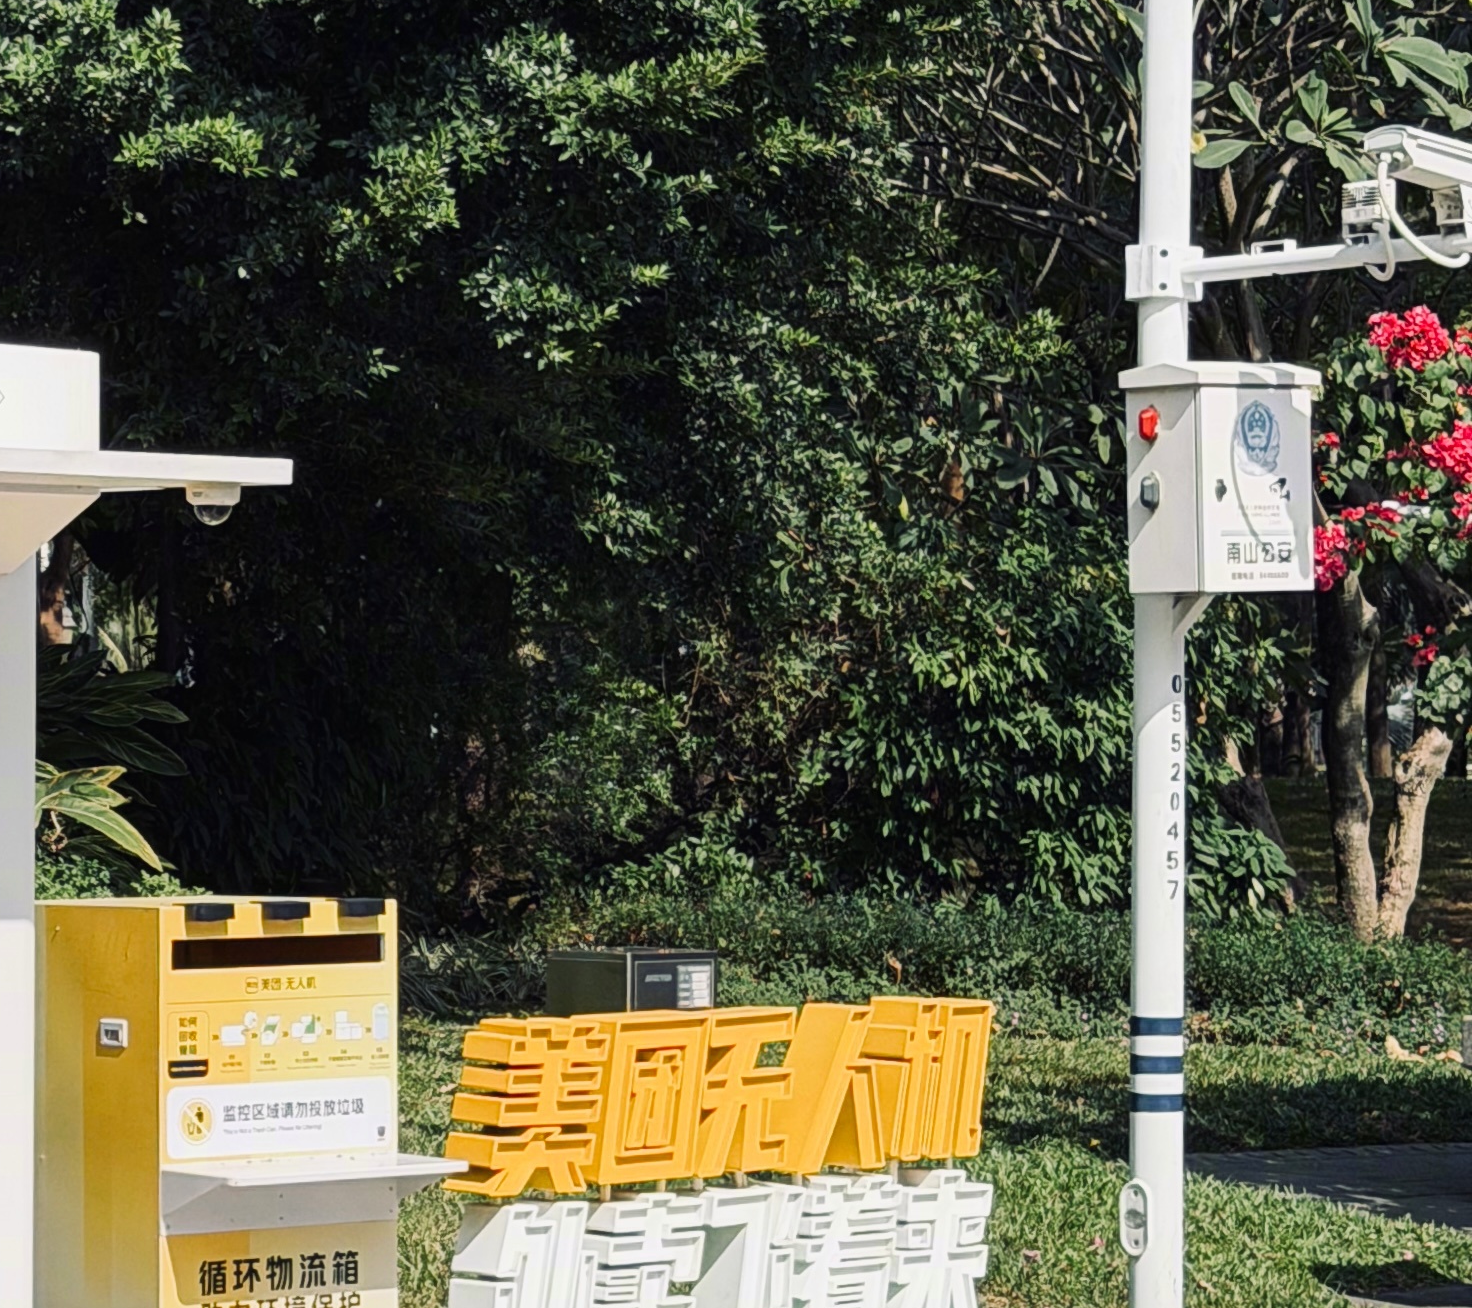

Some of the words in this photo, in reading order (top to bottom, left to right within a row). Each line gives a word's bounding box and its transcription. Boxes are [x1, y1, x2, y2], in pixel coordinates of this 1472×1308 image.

[1227, 542, 1292, 564] 南山公安
[1167, 674, 1183, 900] 05520457
[222, 1098, 365, 1123] 监控区域请勿投放垃圾
[443, 996, 995, 1196] 美团无人机
[199, 1250, 359, 1296] 循环物流箱
